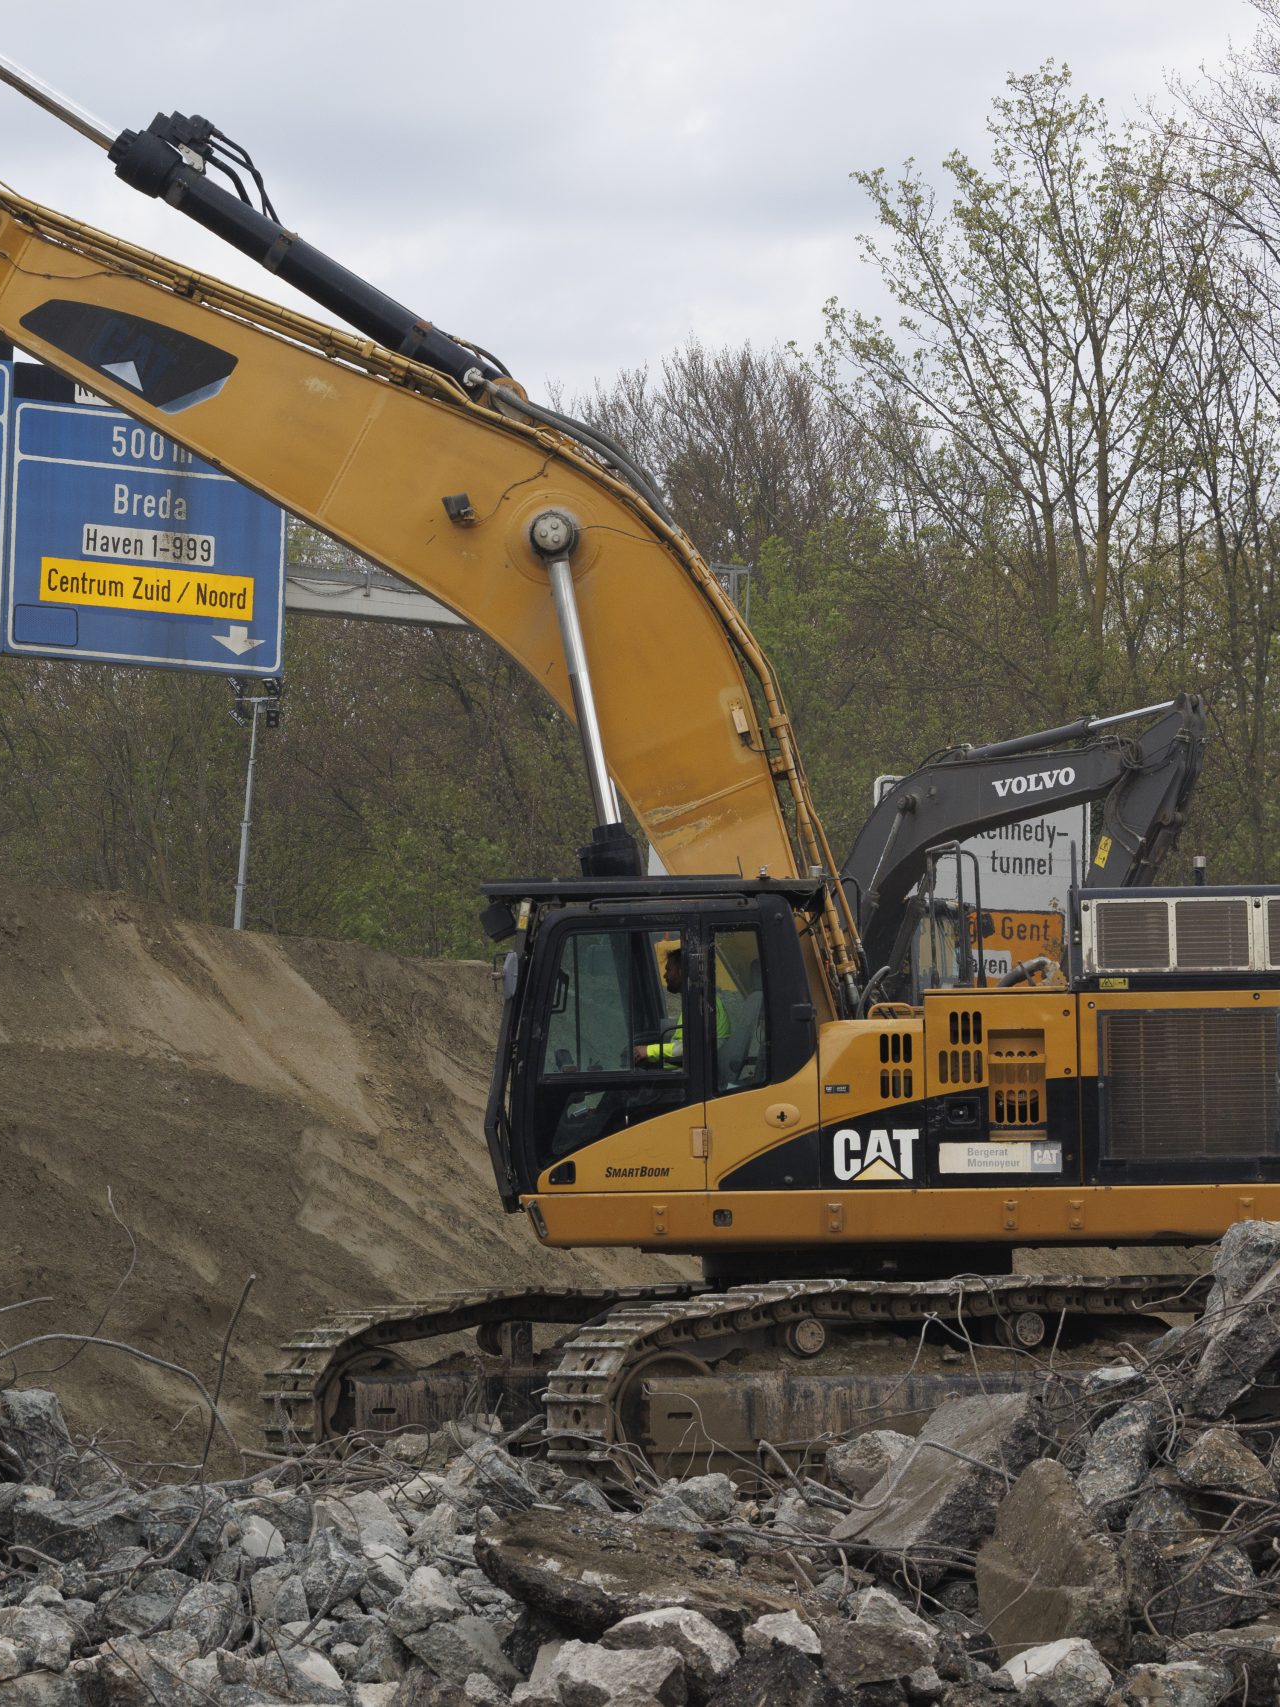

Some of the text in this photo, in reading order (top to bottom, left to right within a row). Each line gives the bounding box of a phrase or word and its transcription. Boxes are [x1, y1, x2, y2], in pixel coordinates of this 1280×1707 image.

[111, 426, 165, 462] 500
[113, 484, 188, 520] Breda
[86, 528, 212, 562] Haven 1-999
[47, 568, 124, 598] Centrum
[133, 577, 171, 602] Zuid
[196, 583, 247, 610] Noord
[991, 767, 1076, 798] VOLVO
[990, 850, 1053, 875] tunnel
[1001, 916, 1050, 942] Gent
[833, 1128, 920, 1181] CAT
[967, 1147, 1008, 1158] Bergerat
[967, 1158, 1020, 1168] Monnoyeur
[1033, 1149, 1058, 1165] CAT
